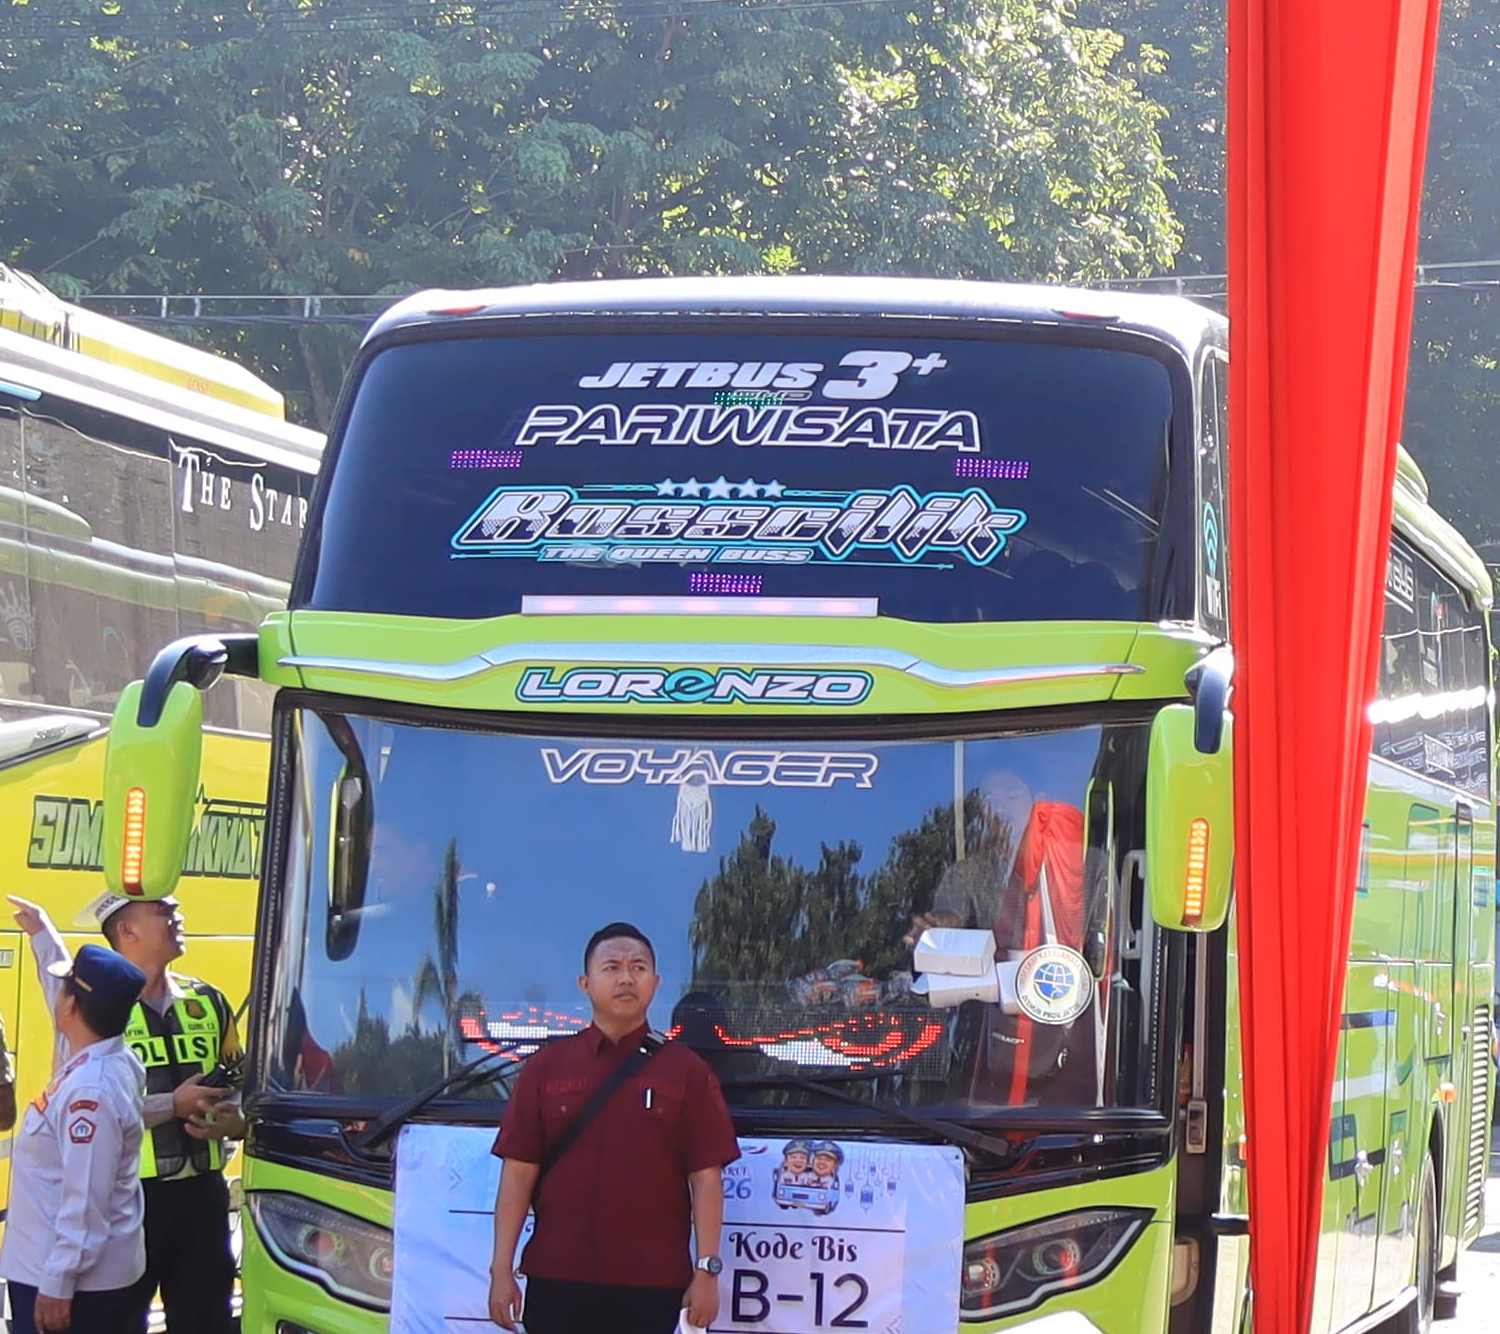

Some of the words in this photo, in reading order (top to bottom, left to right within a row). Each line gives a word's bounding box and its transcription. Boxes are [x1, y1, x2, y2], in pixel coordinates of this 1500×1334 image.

[579, 362, 824, 388] JETBUS
[514, 404, 982, 452] PARIWISATA
[540, 547, 601, 561] THE
[610, 547, 711, 562] QUEEN
[718, 548, 814, 563] BUSS
[541, 748, 879, 788] VOYAGER
[722, 1177, 753, 1200] 26
[728, 1230, 804, 1263] Kode
[810, 1234, 858, 1263] Bis
[731, 1269, 870, 1329] B-12
